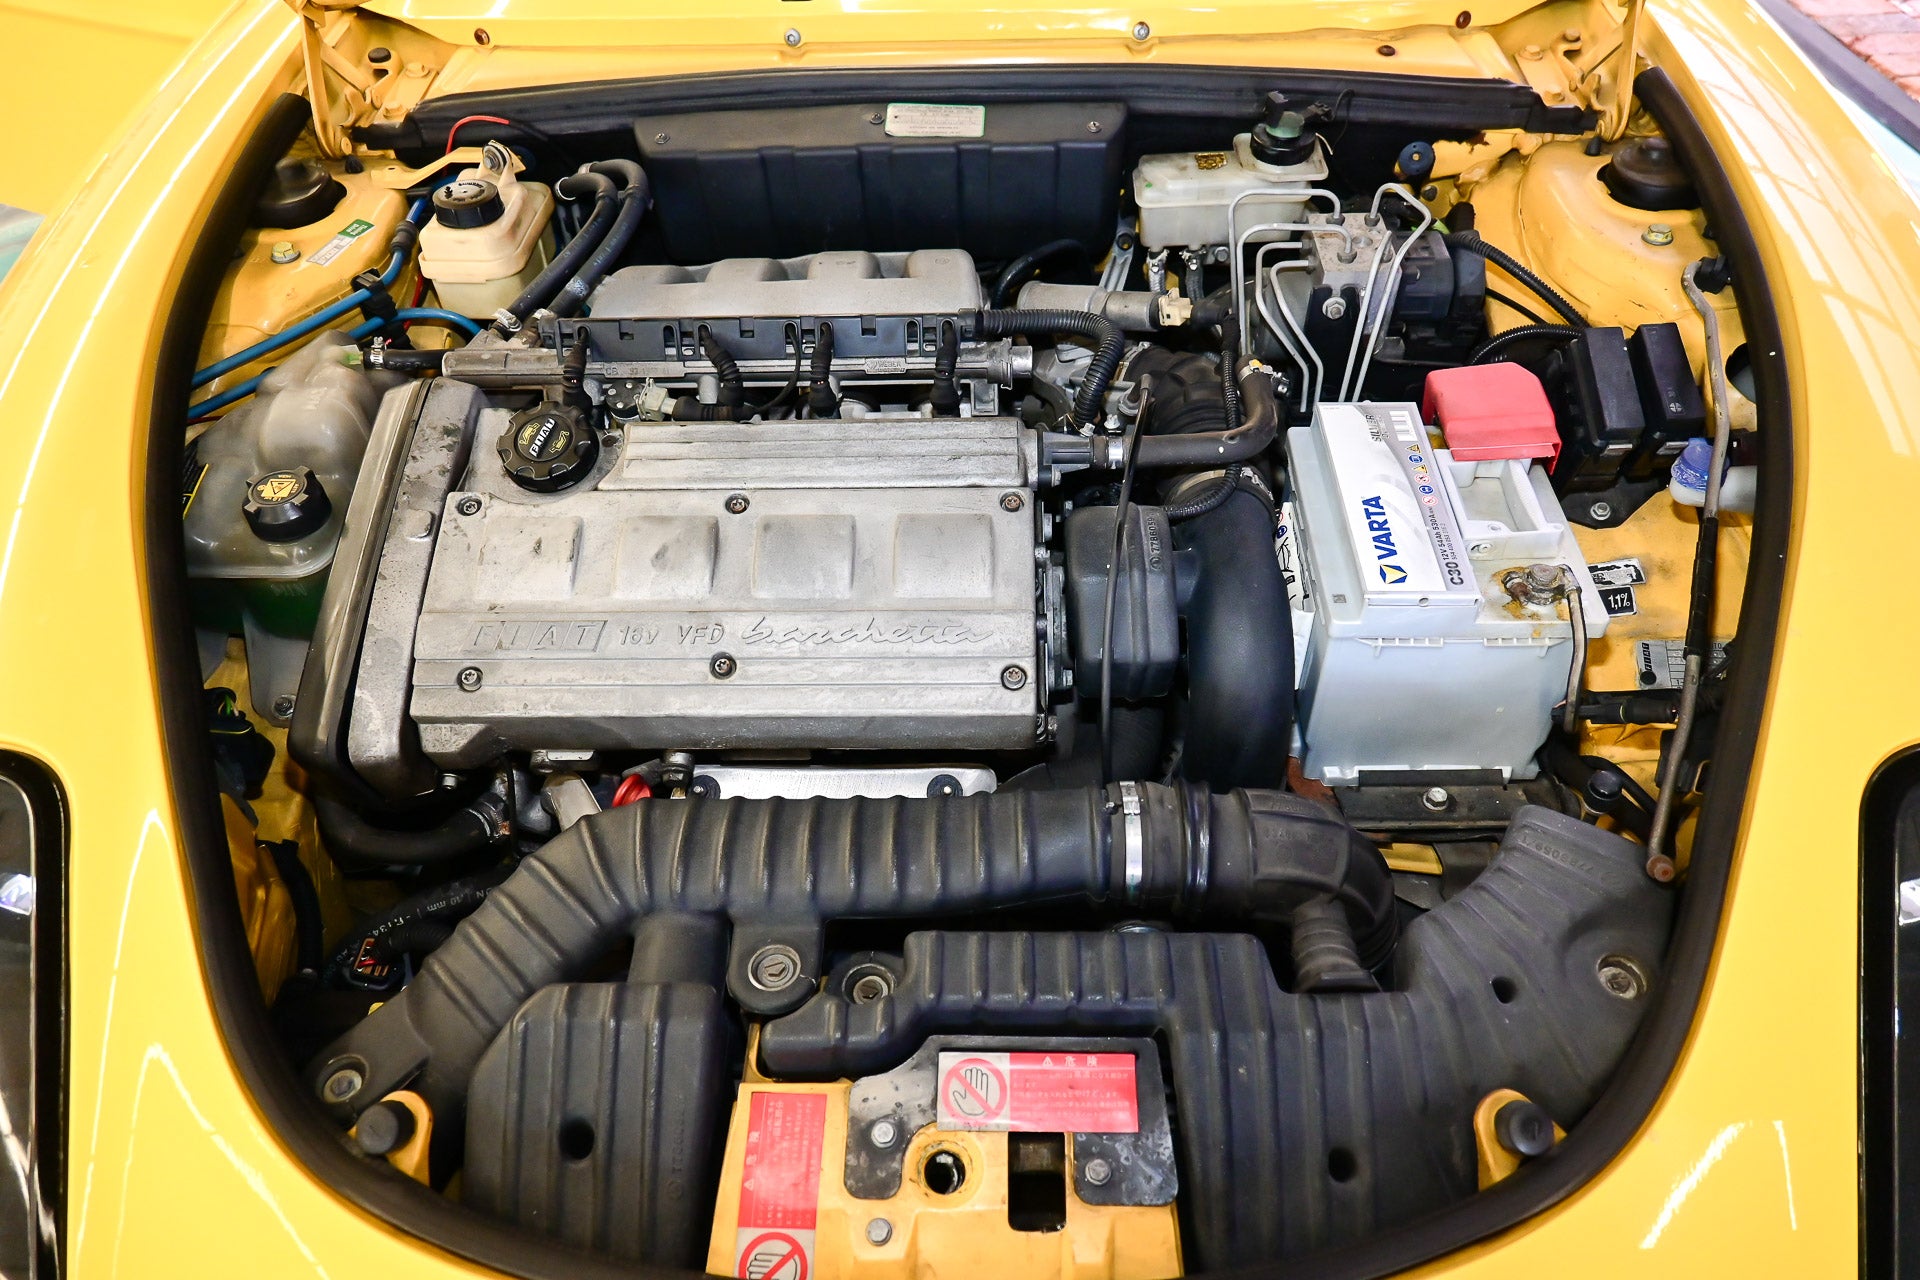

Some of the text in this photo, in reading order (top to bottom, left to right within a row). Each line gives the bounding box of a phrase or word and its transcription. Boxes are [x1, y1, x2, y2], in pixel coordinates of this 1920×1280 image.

[528, 417, 556, 458] FIAT
[1361, 495, 1398, 561] VARTA
[1434, 531, 1446, 549] 54Ah
[1444, 561, 1465, 586] C30
[1608, 592, 1631, 610] 1,1%
[470, 622, 606, 650] FIAT
[677, 623, 725, 646] VFD
[741, 616, 995, 645] barchetta
